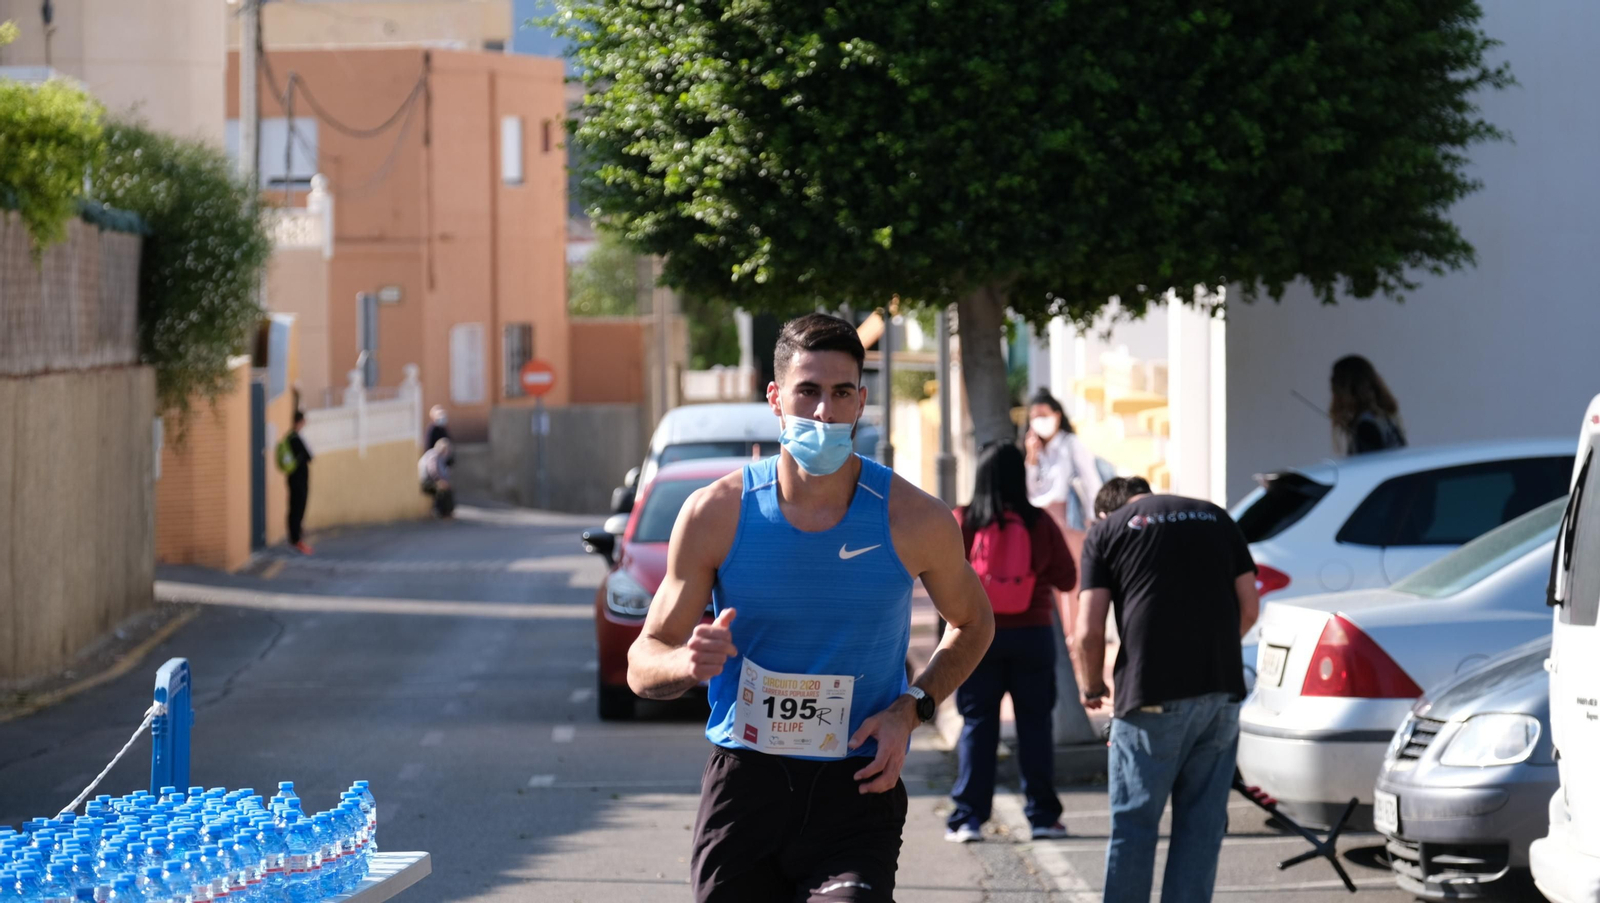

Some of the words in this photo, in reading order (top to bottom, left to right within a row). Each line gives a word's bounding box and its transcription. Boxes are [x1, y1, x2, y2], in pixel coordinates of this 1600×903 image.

[763, 676, 798, 689] CIRCUITO
[762, 686, 788, 696] CARRERAS
[762, 696, 817, 720] 195
[816, 708, 832, 726] R
[771, 722, 804, 732] FELIPE
